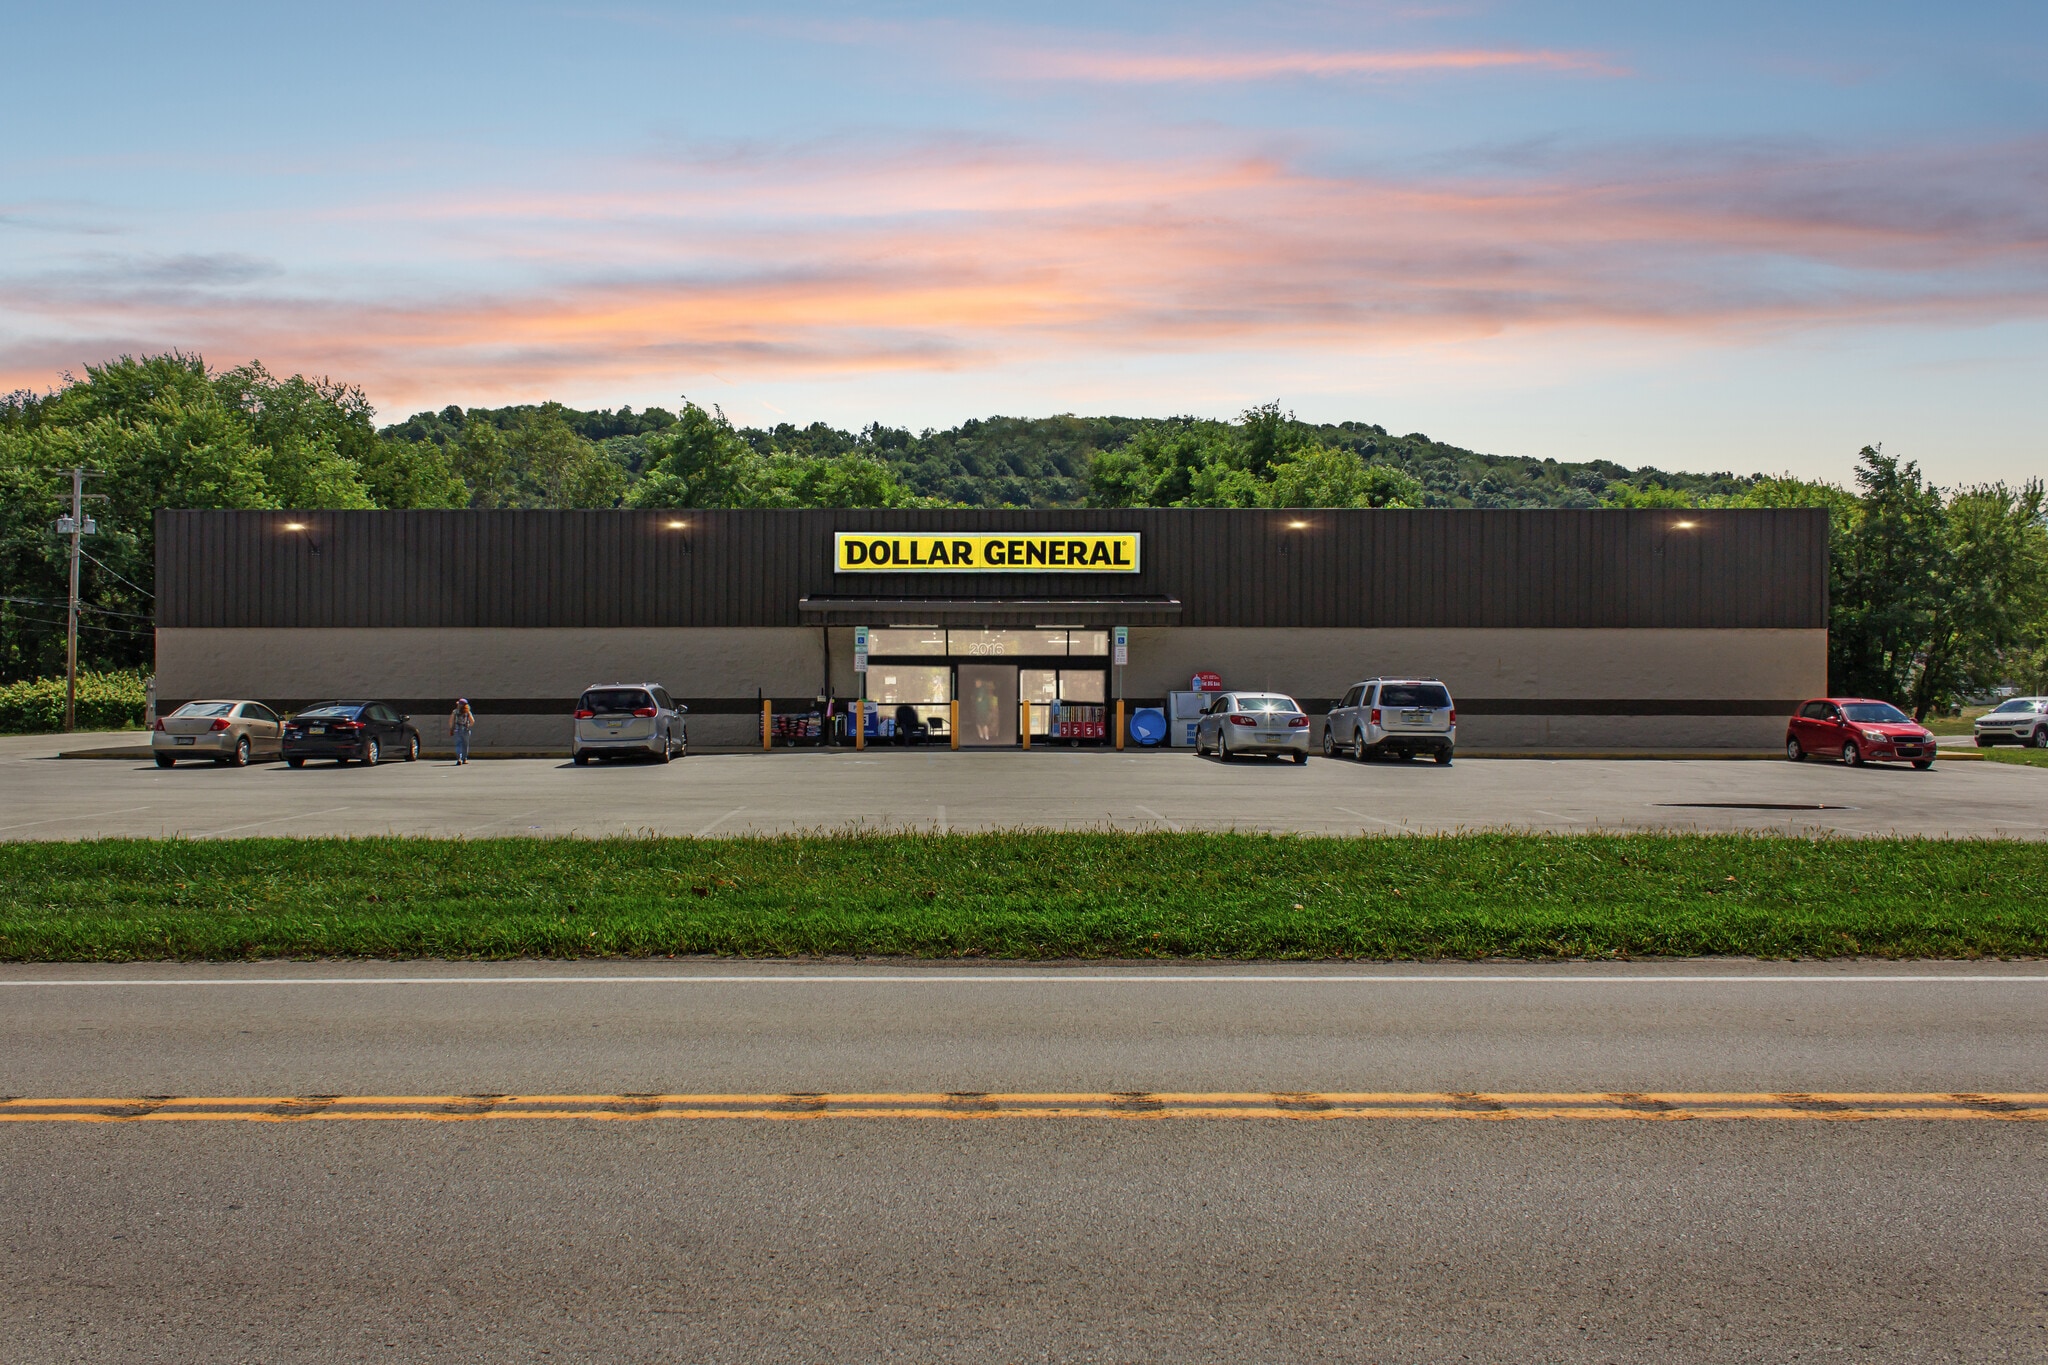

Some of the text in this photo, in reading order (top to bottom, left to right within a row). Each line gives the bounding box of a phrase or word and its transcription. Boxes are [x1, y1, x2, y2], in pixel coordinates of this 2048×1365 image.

[844, 540, 1130, 566] DOLLAR GENERAL
[968, 642, 1005, 656] 2016
